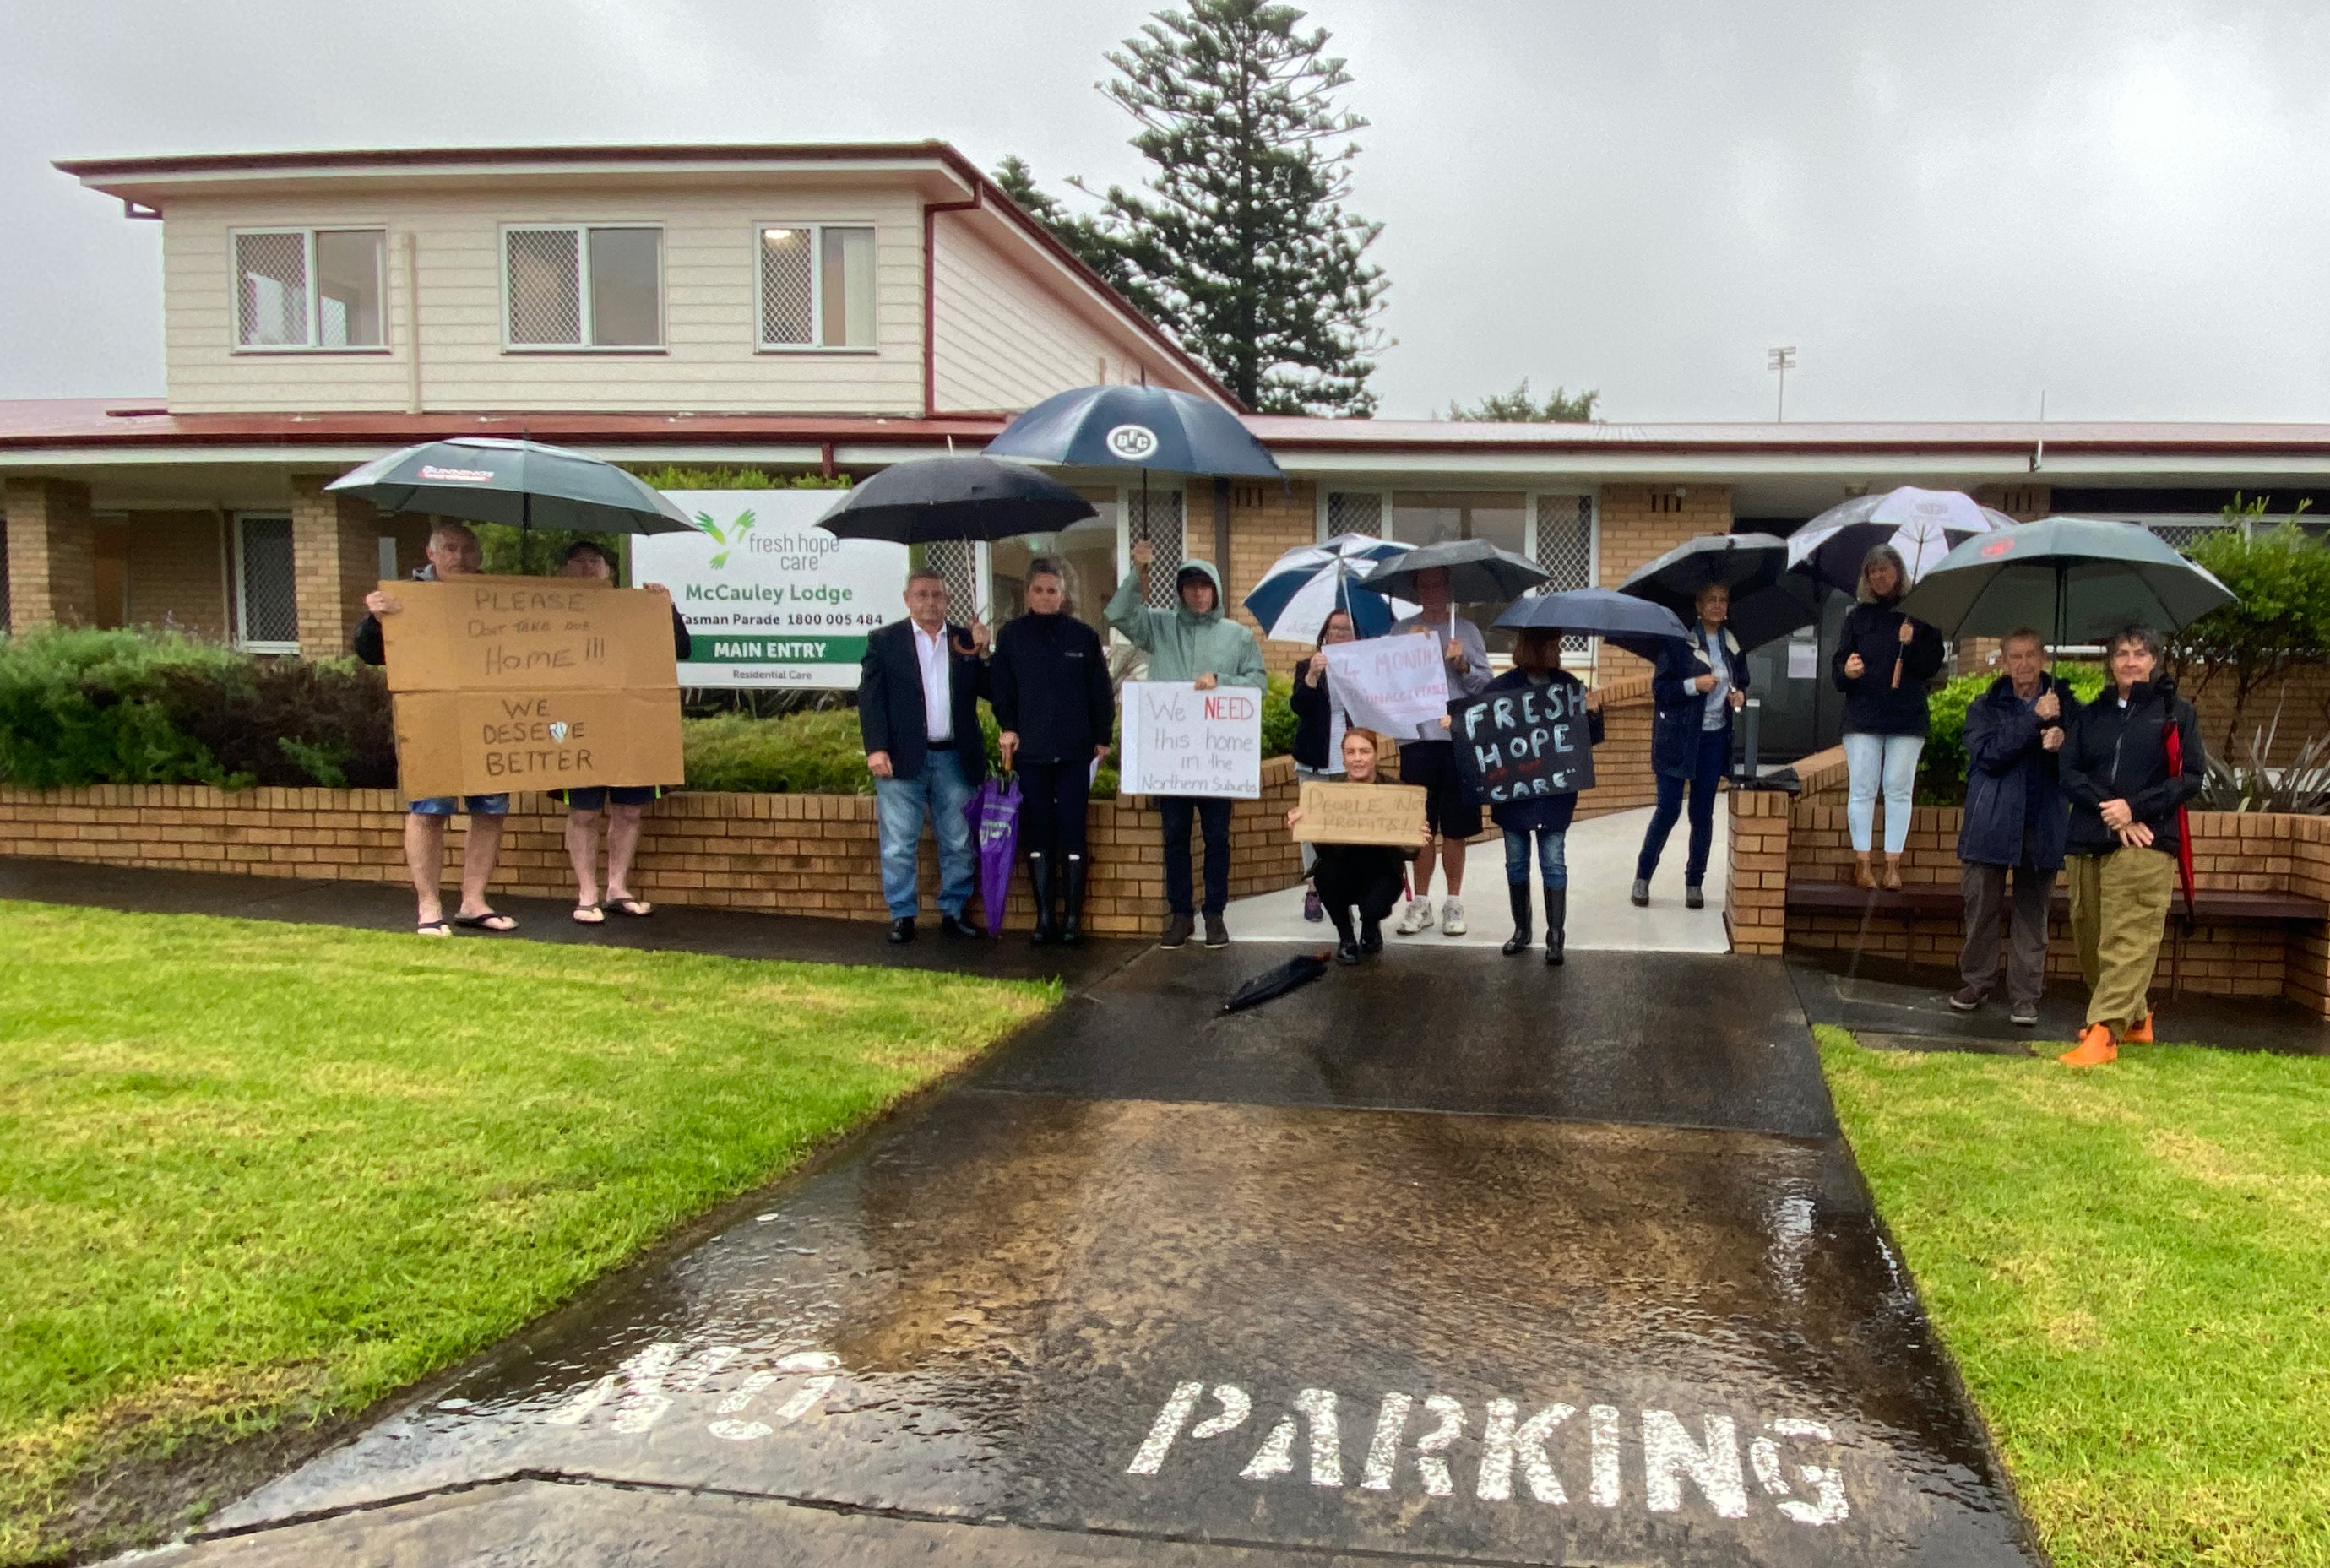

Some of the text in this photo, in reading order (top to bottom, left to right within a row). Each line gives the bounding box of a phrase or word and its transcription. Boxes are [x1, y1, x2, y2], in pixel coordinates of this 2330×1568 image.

[749, 533, 840, 557] fresh hope
[780, 554, 819, 571] care
[475, 588, 588, 612] PLEASE
[685, 583, 854, 605] McCauley Lodge
[733, 613, 780, 626] Parade
[787, 614, 822, 626] 1800
[826, 614, 852, 626] 005
[856, 614, 883, 626] 484
[714, 642, 828, 659] MAIN ENTRY
[733, 670, 812, 681] Residential Care
[502, 699, 551, 719] WE
[1147, 692, 1255, 721] We NEED
[1464, 683, 1588, 741] FRESH
[1205, 728, 1253, 751] home
[1475, 724, 1575, 773] HOPE
[486, 748, 594, 776] BETTER
[1181, 753, 1233, 770] in the
[1141, 773, 1257, 793] Northern Suburbs
[546, 1343, 845, 1440] NO
[1125, 1381, 1850, 1524] PARKING
